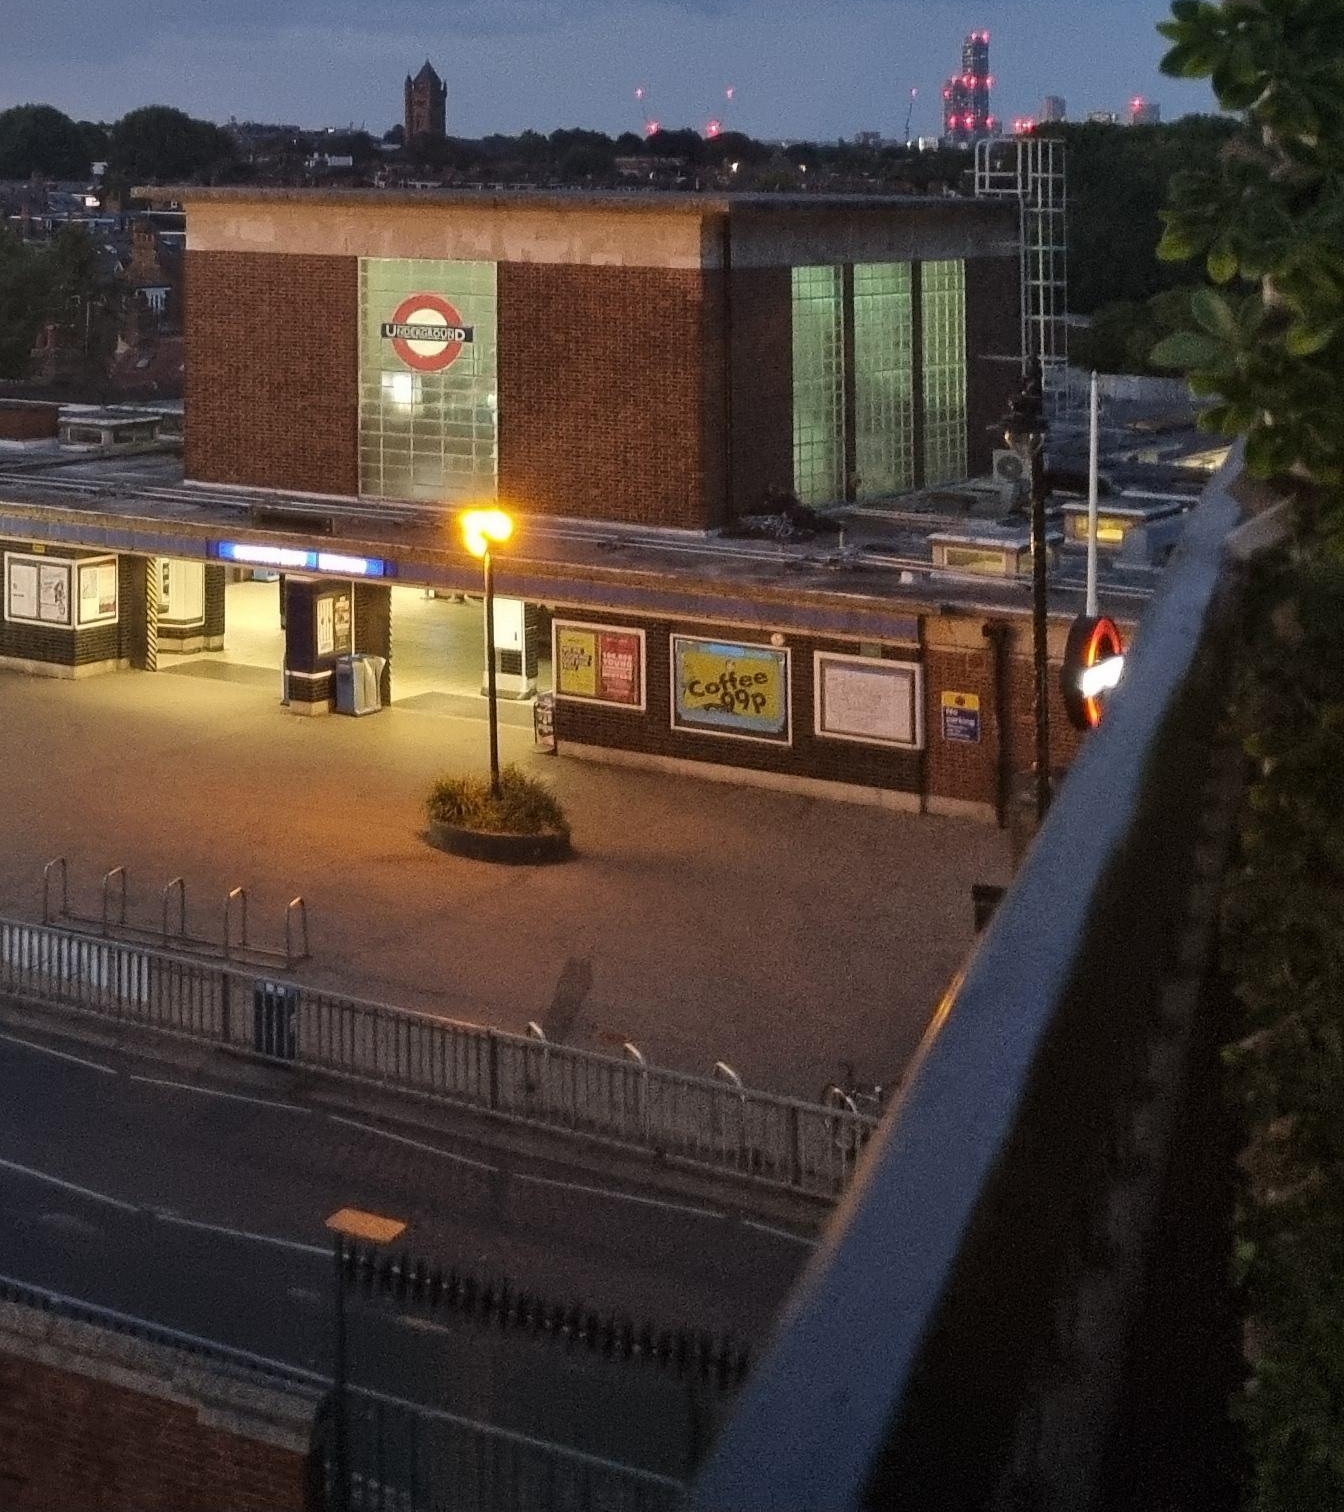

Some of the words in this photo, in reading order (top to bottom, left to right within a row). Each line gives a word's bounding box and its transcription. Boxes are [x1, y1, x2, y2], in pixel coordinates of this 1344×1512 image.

[385, 324, 466, 341] UNDERGROUND
[688, 671, 769, 697] Coffee
[720, 688, 767, 714] 99p
